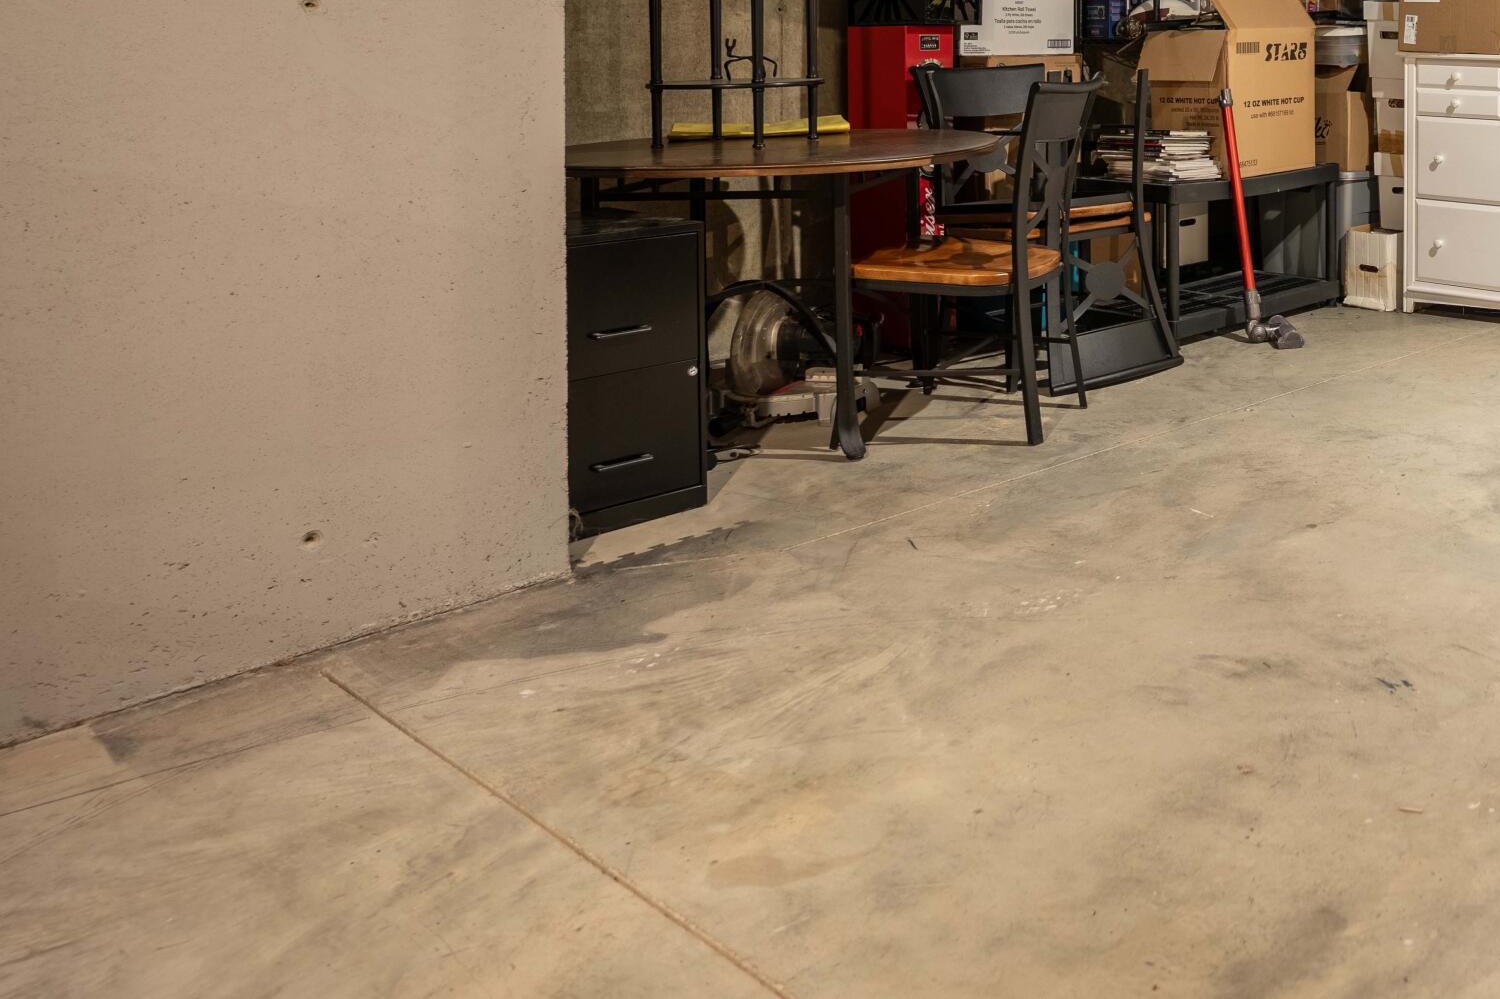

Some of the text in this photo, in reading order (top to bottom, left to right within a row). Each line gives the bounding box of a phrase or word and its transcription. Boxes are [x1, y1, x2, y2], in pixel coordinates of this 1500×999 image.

[1261, 98, 1280, 107] WHITE
[1280, 97, 1292, 105] HOT
[1293, 96, 1305, 104] CUP
